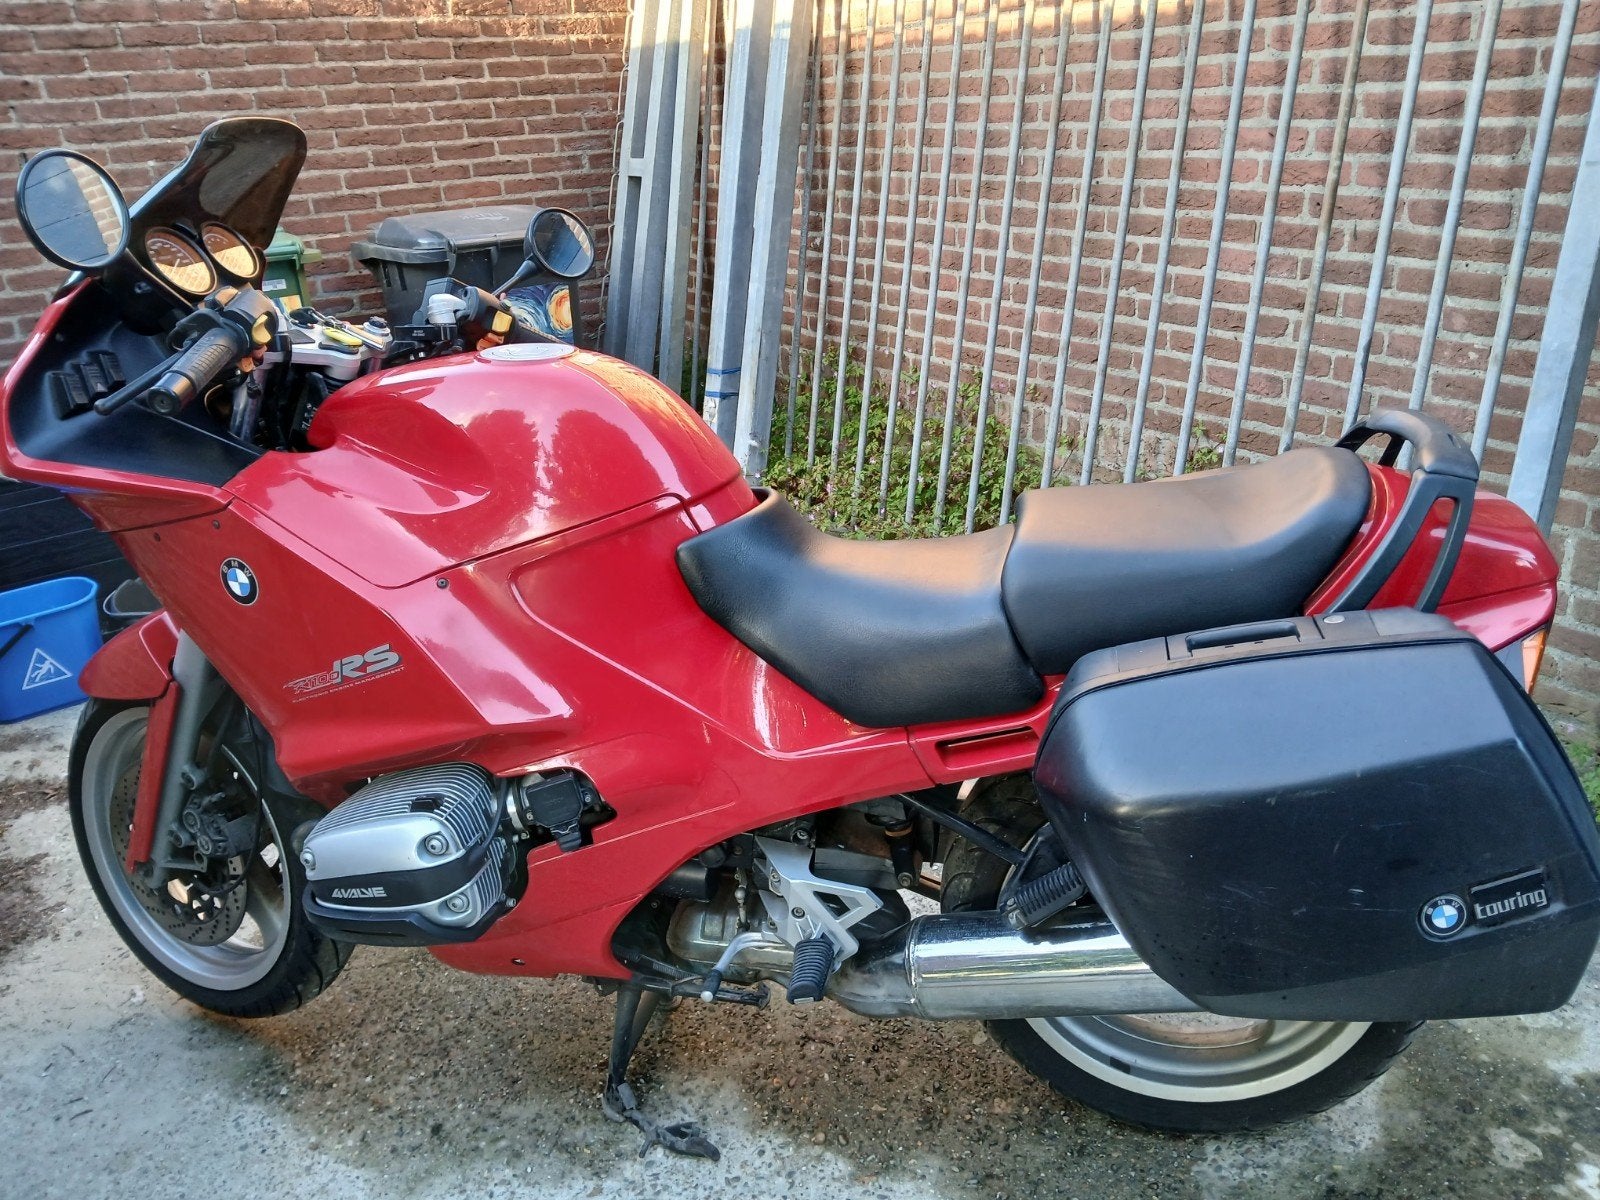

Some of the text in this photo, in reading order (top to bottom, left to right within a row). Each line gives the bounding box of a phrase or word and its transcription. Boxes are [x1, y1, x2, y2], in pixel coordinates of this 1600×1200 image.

[222, 560, 252, 577] BMW
[1426, 899, 1460, 915] BMW
[1473, 888, 1548, 920] touring
